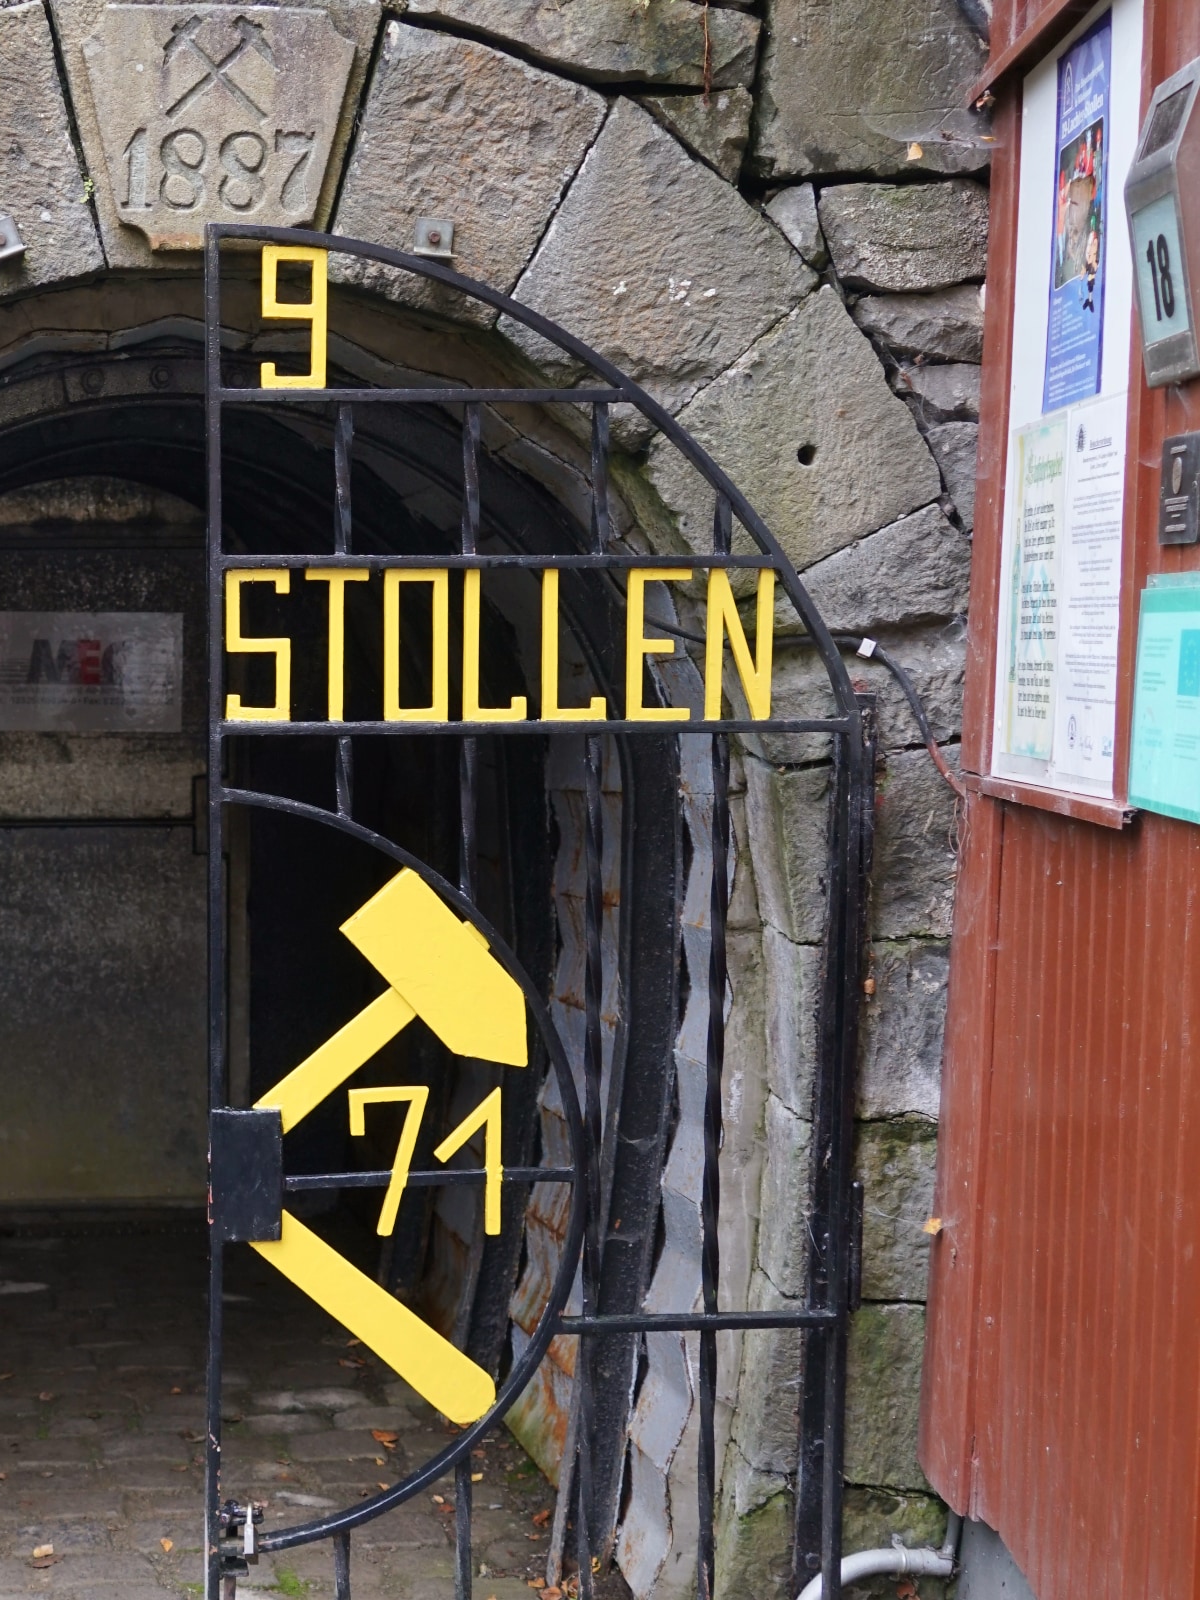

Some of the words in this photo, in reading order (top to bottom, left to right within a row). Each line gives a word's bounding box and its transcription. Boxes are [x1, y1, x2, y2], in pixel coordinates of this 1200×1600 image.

[120, 127, 316, 216] 1887
[261, 245, 328, 389] 9
[1146, 233, 1175, 321] 18
[225, 567, 776, 721] STOLLEN
[348, 1085, 502, 1236] 71
